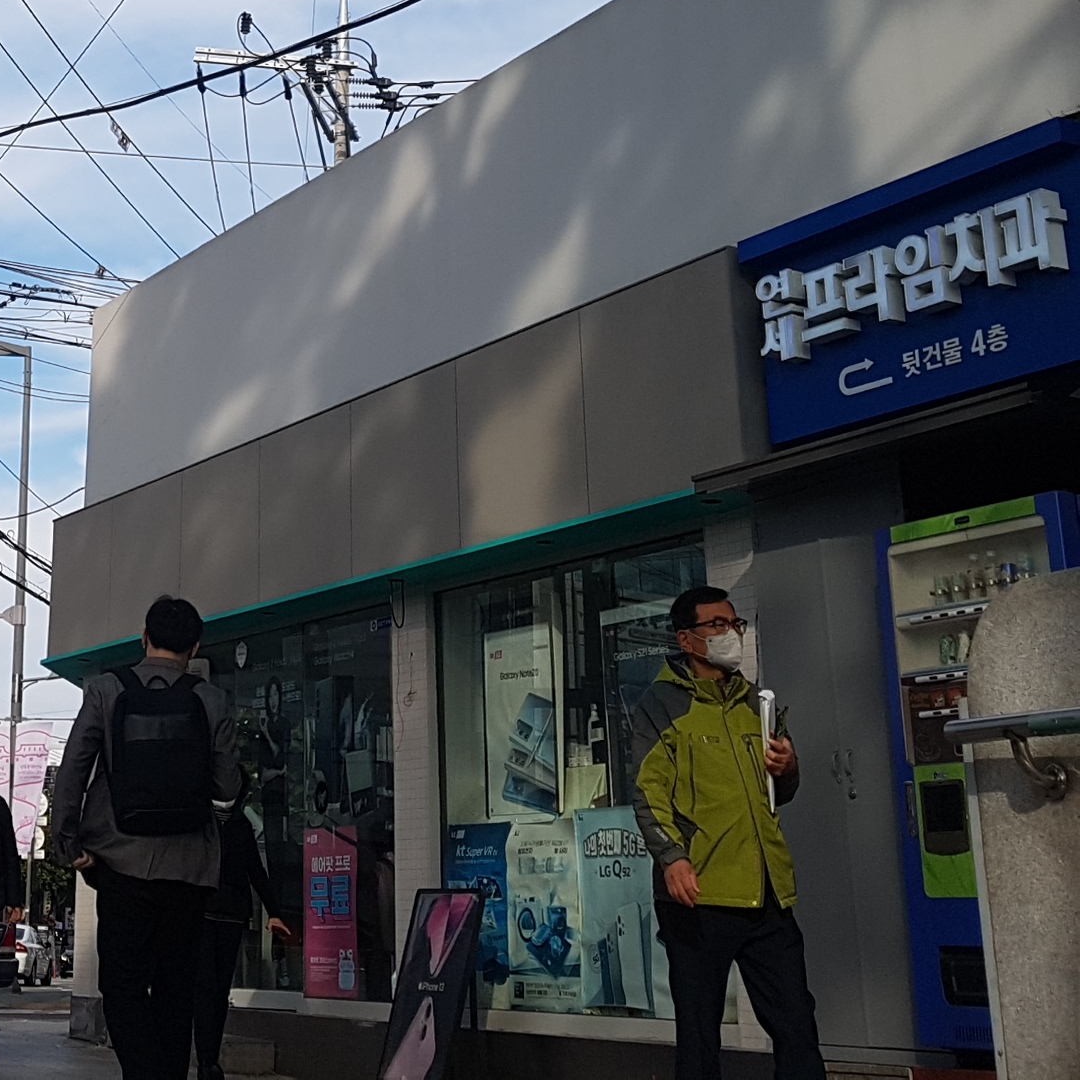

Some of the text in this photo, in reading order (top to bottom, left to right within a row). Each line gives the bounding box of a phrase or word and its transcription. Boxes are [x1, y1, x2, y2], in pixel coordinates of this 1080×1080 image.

[901, 323, 1009, 378] 뒷건물 4층
[622, 829, 636, 858] 5G
[311, 855, 351, 872] 에어팟 프로
[599, 865, 611, 877] LG
[310, 875, 351, 919] 무료
